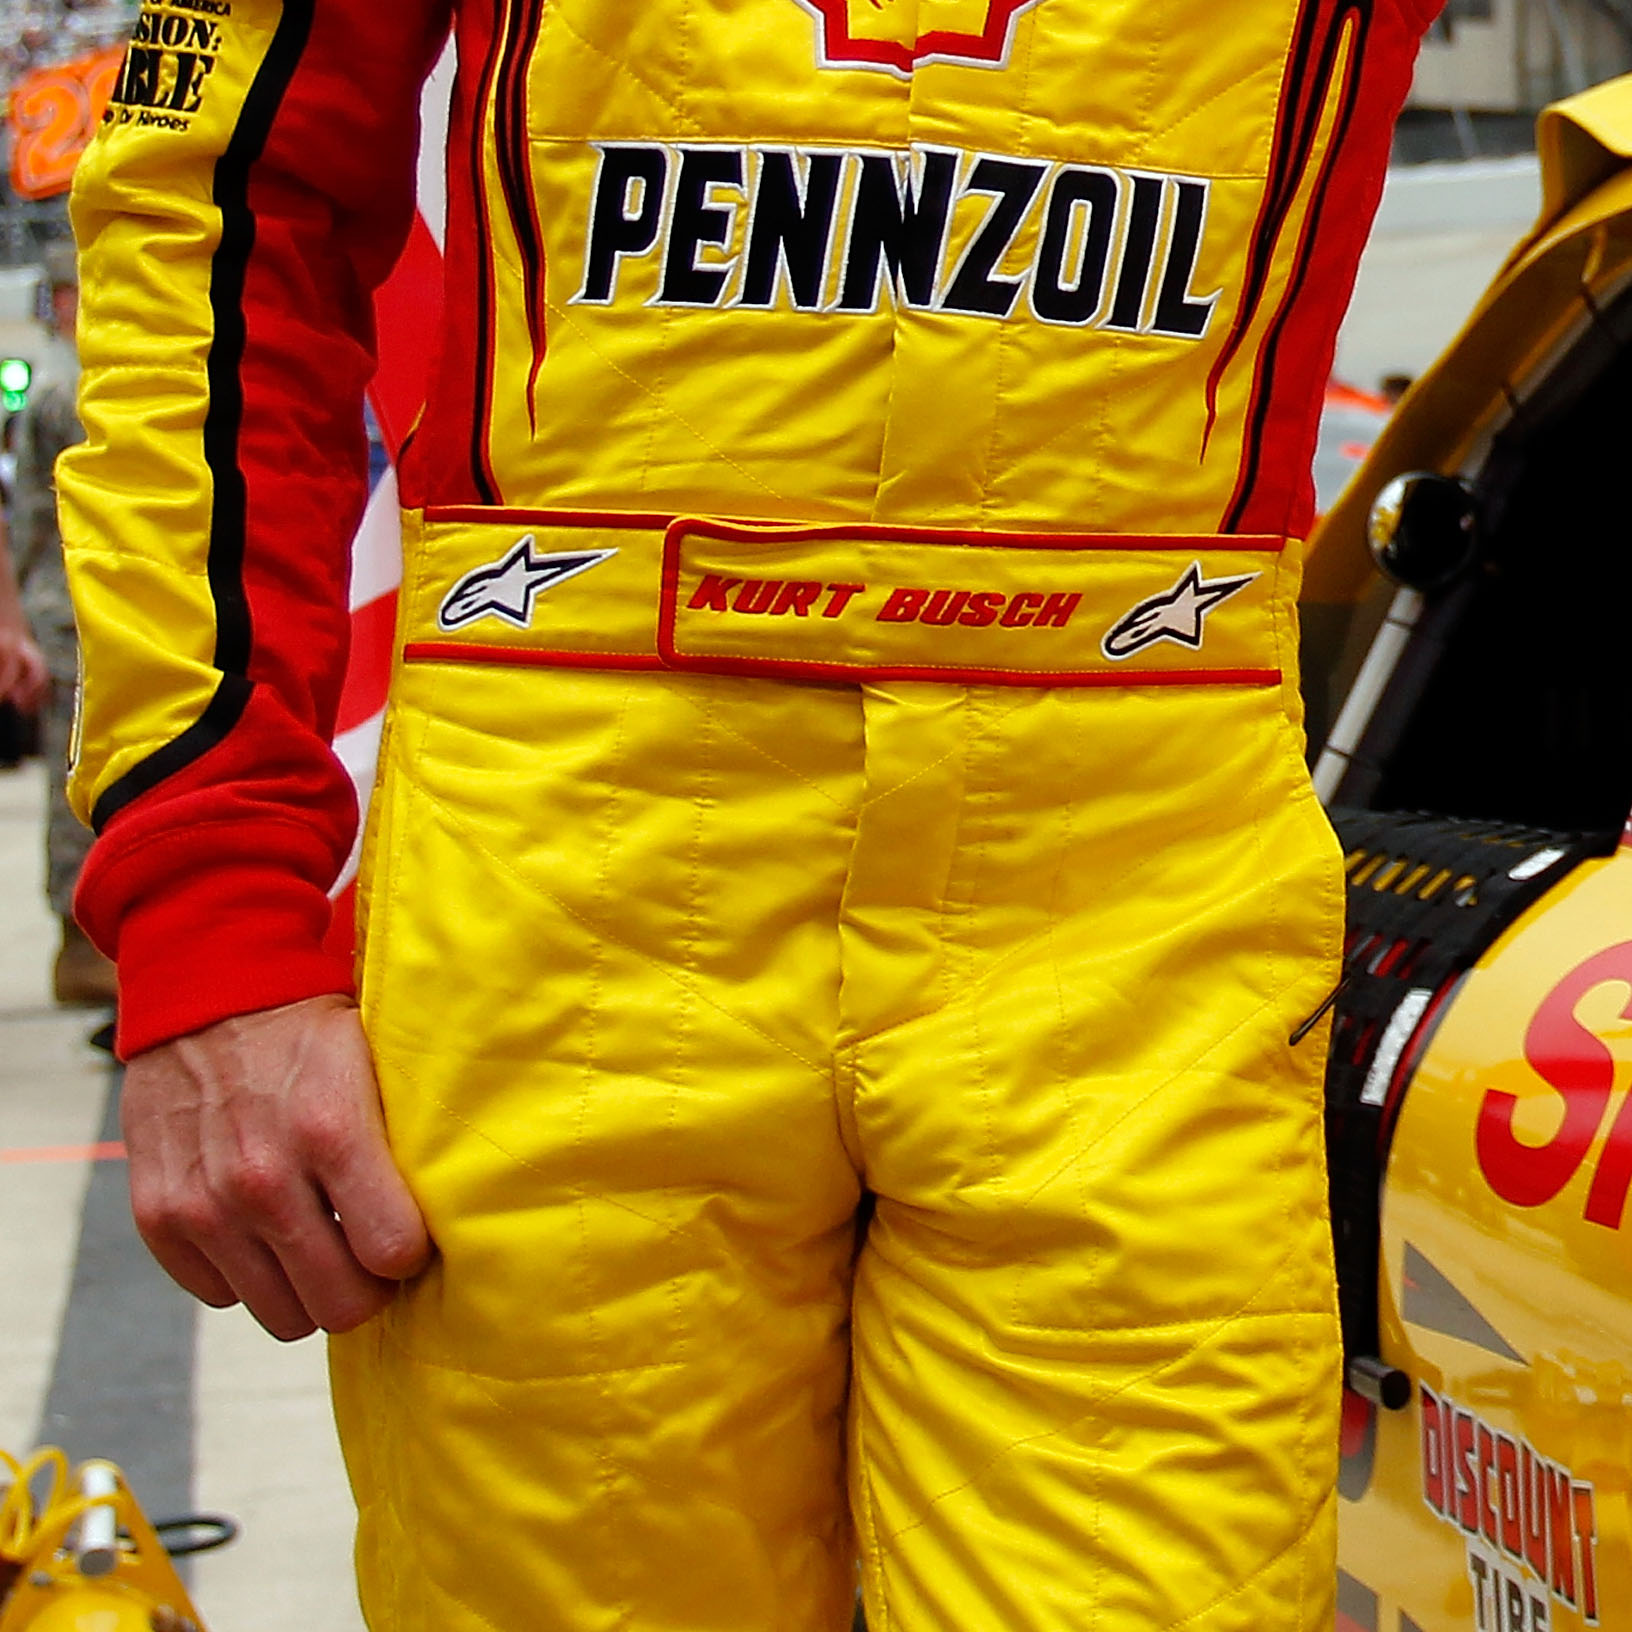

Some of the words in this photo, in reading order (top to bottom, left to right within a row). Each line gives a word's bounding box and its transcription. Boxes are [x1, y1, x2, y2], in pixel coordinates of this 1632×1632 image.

[569, 141, 1223, 339] PENNZOIL
[686, 573, 867, 619] KURT
[876, 586, 1084, 628] BUSCH
[1419, 1378, 1600, 1627] DISCOUNT
